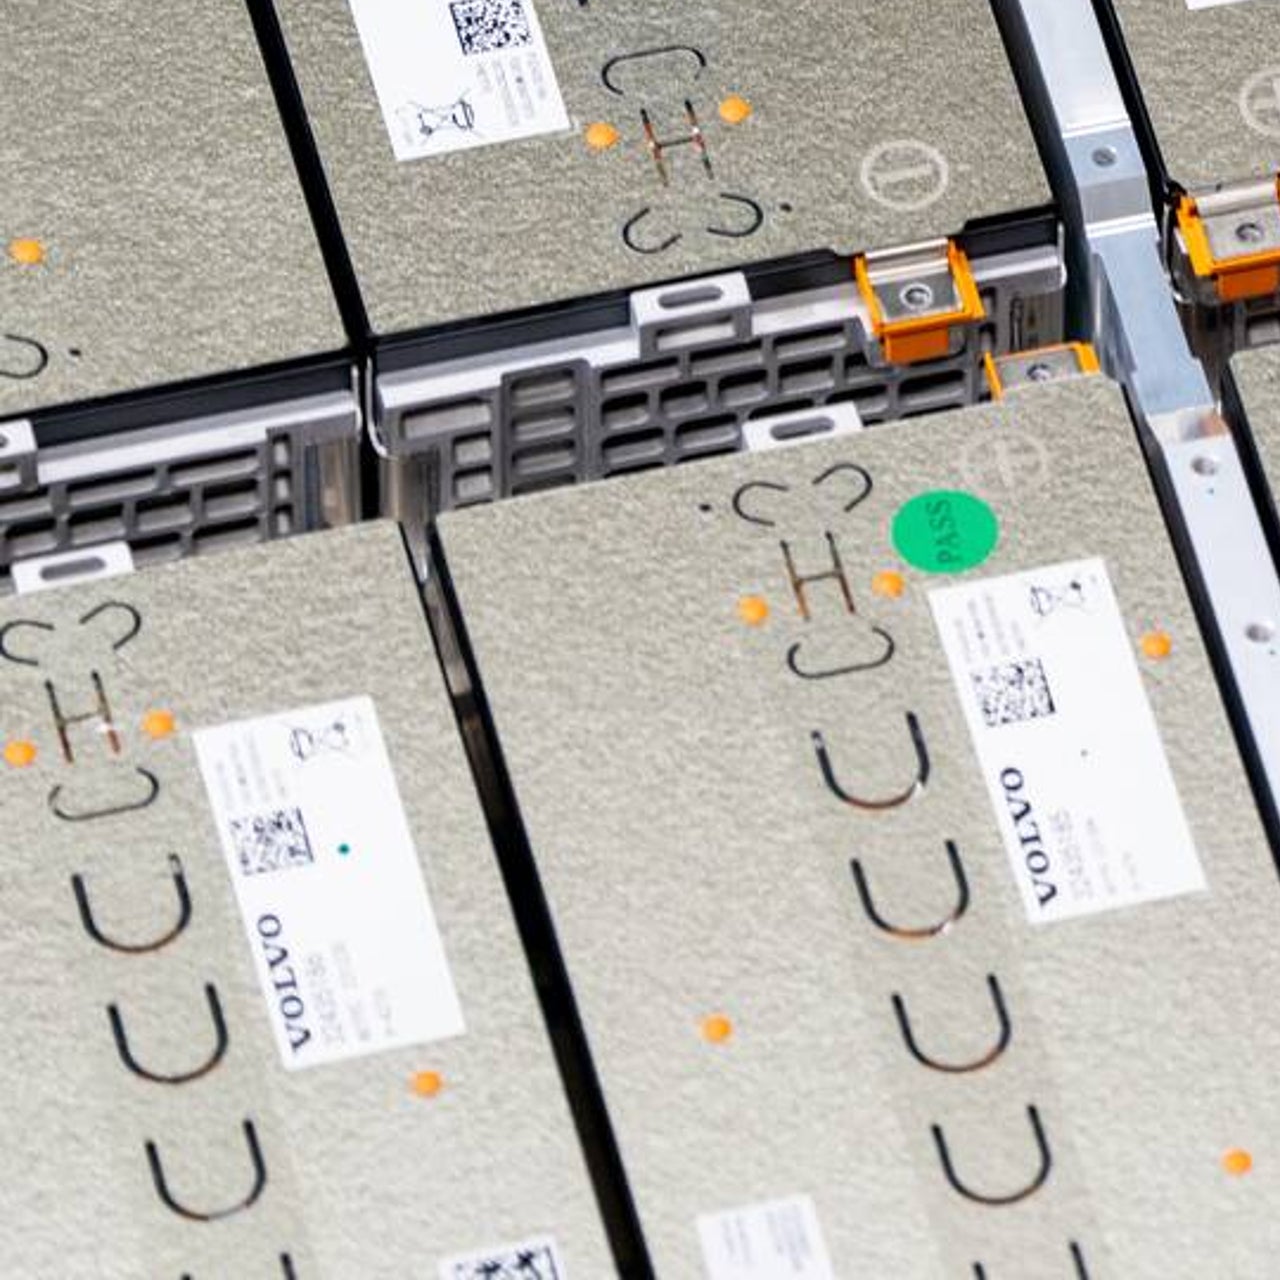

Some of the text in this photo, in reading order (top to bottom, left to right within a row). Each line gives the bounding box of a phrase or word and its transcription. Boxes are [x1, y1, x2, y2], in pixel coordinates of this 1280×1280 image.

[925, 499, 963, 565] PASS
[1000, 767, 1058, 907] VOLVO
[257, 914, 311, 1052] VOLVO
